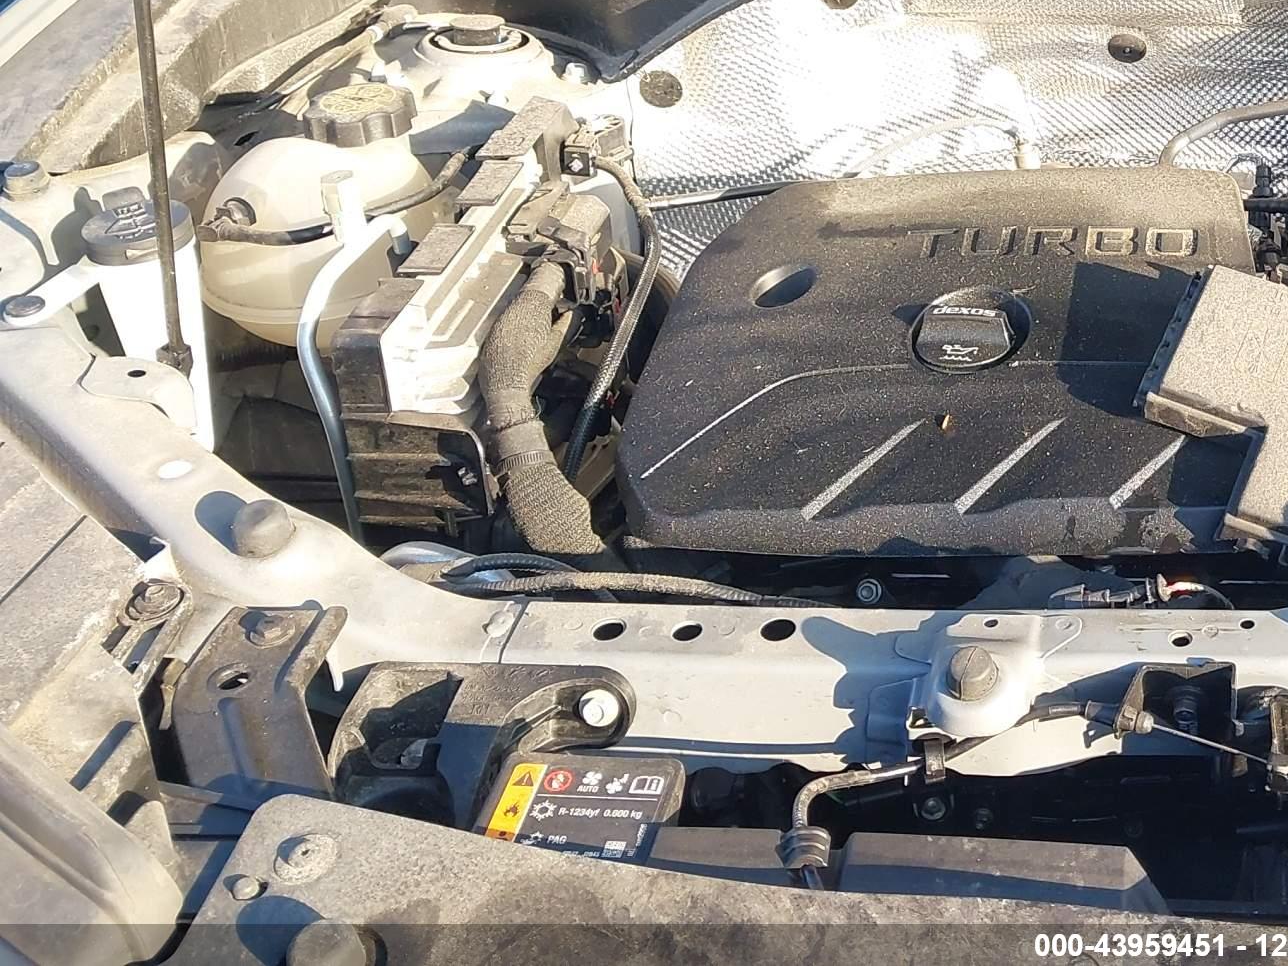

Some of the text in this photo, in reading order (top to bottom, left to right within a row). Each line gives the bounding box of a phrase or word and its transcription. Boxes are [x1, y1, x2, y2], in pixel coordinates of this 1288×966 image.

[907, 225, 1198, 258] TURBO
[932, 305, 997, 317] dexos
[577, 785, 600, 793] AUTO
[558, 808, 600, 818] R-1234yf
[630, 810, 643, 820] kg
[546, 835, 568, 845] PAG
